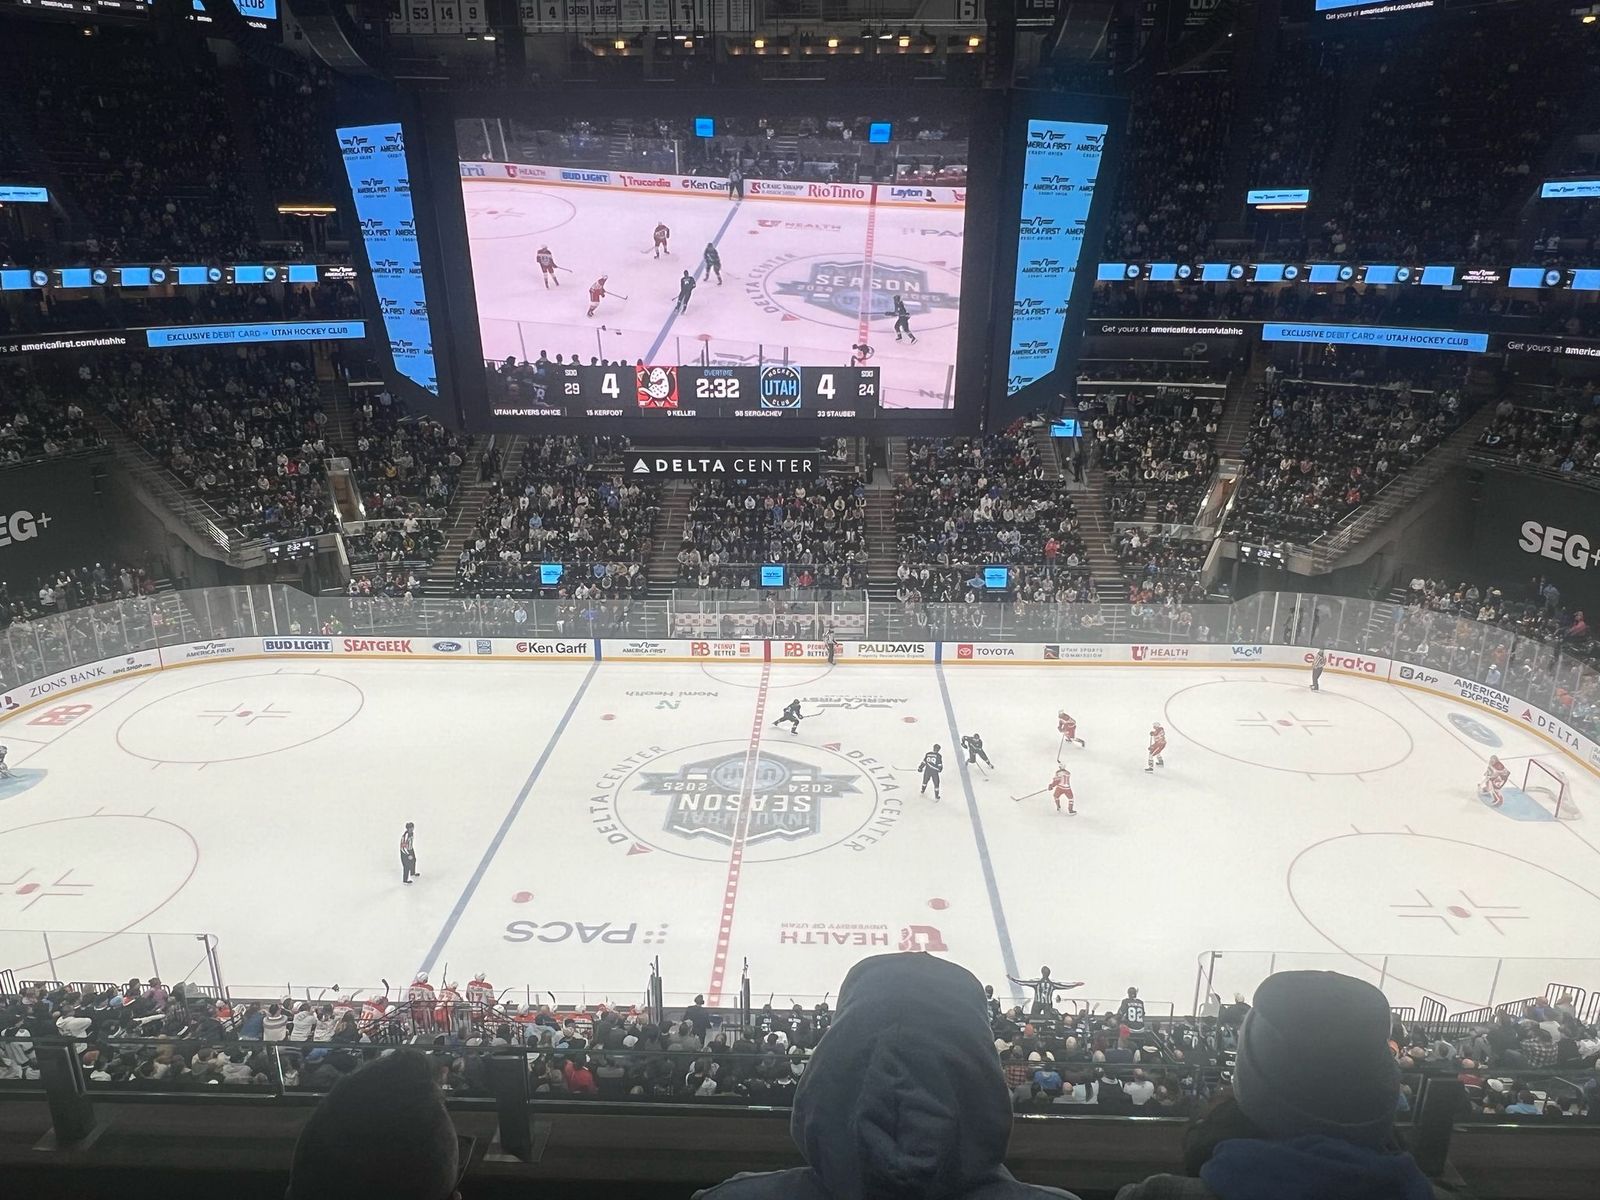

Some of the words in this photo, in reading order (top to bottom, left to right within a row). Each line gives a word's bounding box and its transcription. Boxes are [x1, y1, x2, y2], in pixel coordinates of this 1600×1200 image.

[413, 8, 429, 19] 53
[441, 7, 453, 19] 14
[549, 6, 556, 18] 4
[562, 171, 580, 182] BUD
[582, 172, 608, 183] LIGHT
[690, 179, 707, 190] Ken
[709, 181, 730, 191] Garf
[891, 187, 923, 198] Layton
[815, 274, 921, 292] SEASON
[167, 332, 211, 342] EXCLUSIVE
[212, 330, 236, 339] DEBIT
[238, 329, 261, 338] CARD
[272, 328, 293, 337] UTAH
[294, 328, 326, 336] HOCKEY
[328, 327, 348, 335] CLUB
[1101, 325, 1115, 333] Get
[1117, 326, 1138, 334] yours
[1151, 326, 1244, 336] americafirst.com/utahhc
[1281, 329, 1324, 339] EXCLUSIVE
[1325, 331, 1350, 339] DEBIT
[1351, 332, 1374, 340] CARD
[1386, 334, 1409, 343] UTAH
[1410, 335, 1446, 345] HOCKEY
[1447, 337, 1469, 346] CLUB
[9, 344, 19, 352] at
[21, 336, 126, 351] americafirst.com/utahhc
[1508, 341, 1524, 350] Get
[1527, 344, 1551, 352] yours
[565, 383, 580, 395] 29
[601, 373, 620, 399] 4
[696, 379, 740, 398] 2:32
[765, 380, 797, 396] UTAH
[817, 374, 836, 400] 4
[858, 384, 874, 396] 24
[826, 410, 856, 418] STAUBER
[656, 459, 726, 473] DELTA
[733, 459, 812, 473] CENTER
[186, 649, 216, 658] AMERICA
[217, 647, 235, 655] FIRST
[266, 641, 293, 650] BUD
[294, 641, 330, 651] LIGHT
[344, 639, 413, 653] SEATGEEK
[438, 643, 456, 651] Ford
[529, 642, 553, 654] Ken
[556, 642, 586, 654] Garff
[977, 648, 1014, 656] TOYOTA
[1304, 652, 1376, 673] etrata
[29, 677, 67, 698] ZIONS
[71, 666, 107, 684] BANK
[1454, 679, 1510, 704] AMERICAN
[1460, 689, 1509, 713] EXPRESS
[1537, 715, 1580, 750] DELTA
[596, 745, 668, 789] CENTER
[846, 750, 898, 793] DELTA
[663, 783, 707, 791] 2025
[788, 784, 833, 793] 2024
[678, 794, 812, 812] SEASON
[589, 794, 628, 844] DELTA
[844, 798, 904, 853] CENTER
[503, 920, 637, 944] PACS
[780, 931, 888, 946] HEALTH
